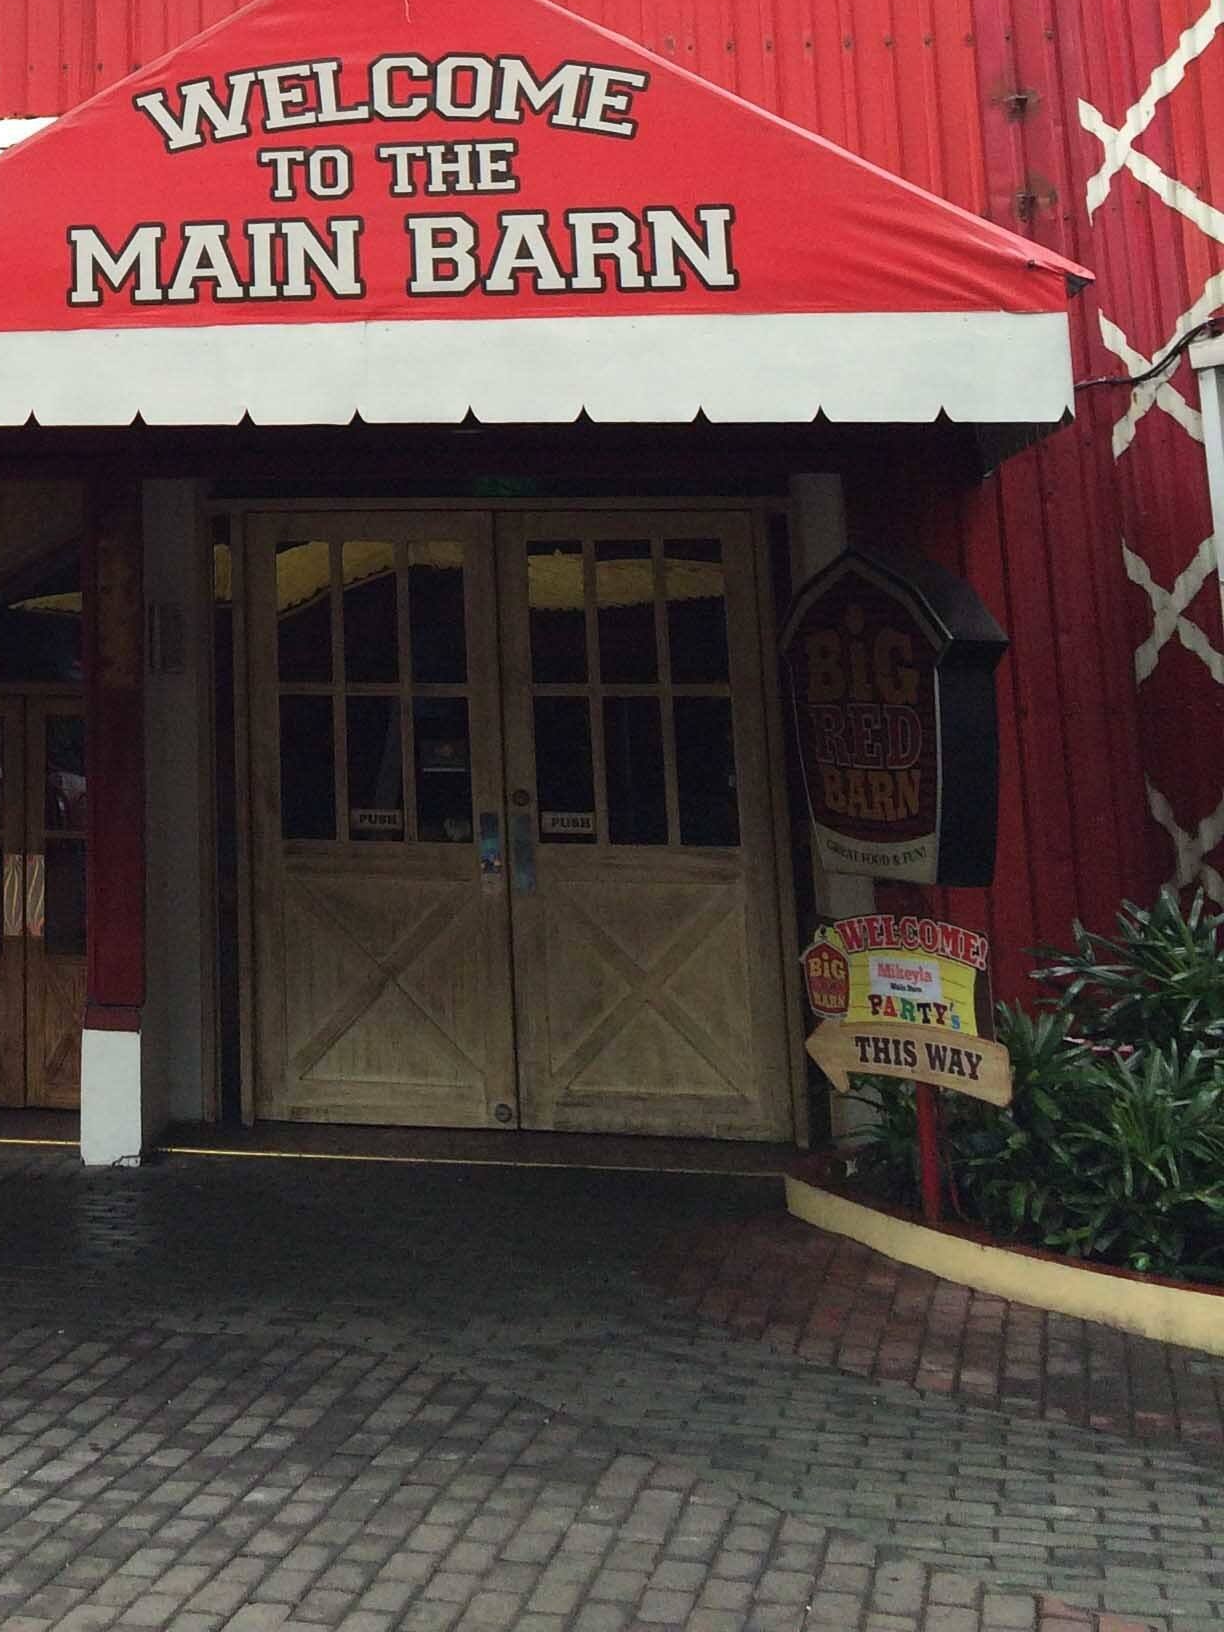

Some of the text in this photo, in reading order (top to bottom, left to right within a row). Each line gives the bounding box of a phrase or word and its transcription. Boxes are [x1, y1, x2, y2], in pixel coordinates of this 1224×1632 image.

[135, 54, 650, 151] WELCOME
[259, 139, 520, 201] TO THE
[66, 203, 739, 308] MAIN BARN
[808, 703, 922, 770] RED
[359, 814, 398, 826] PUSH
[551, 816, 593, 830] PUSH
[823, 768, 921, 822] BARN
[834, 914, 988, 971] WELCOME!
[855, 1035, 983, 1081] THIS WAY
